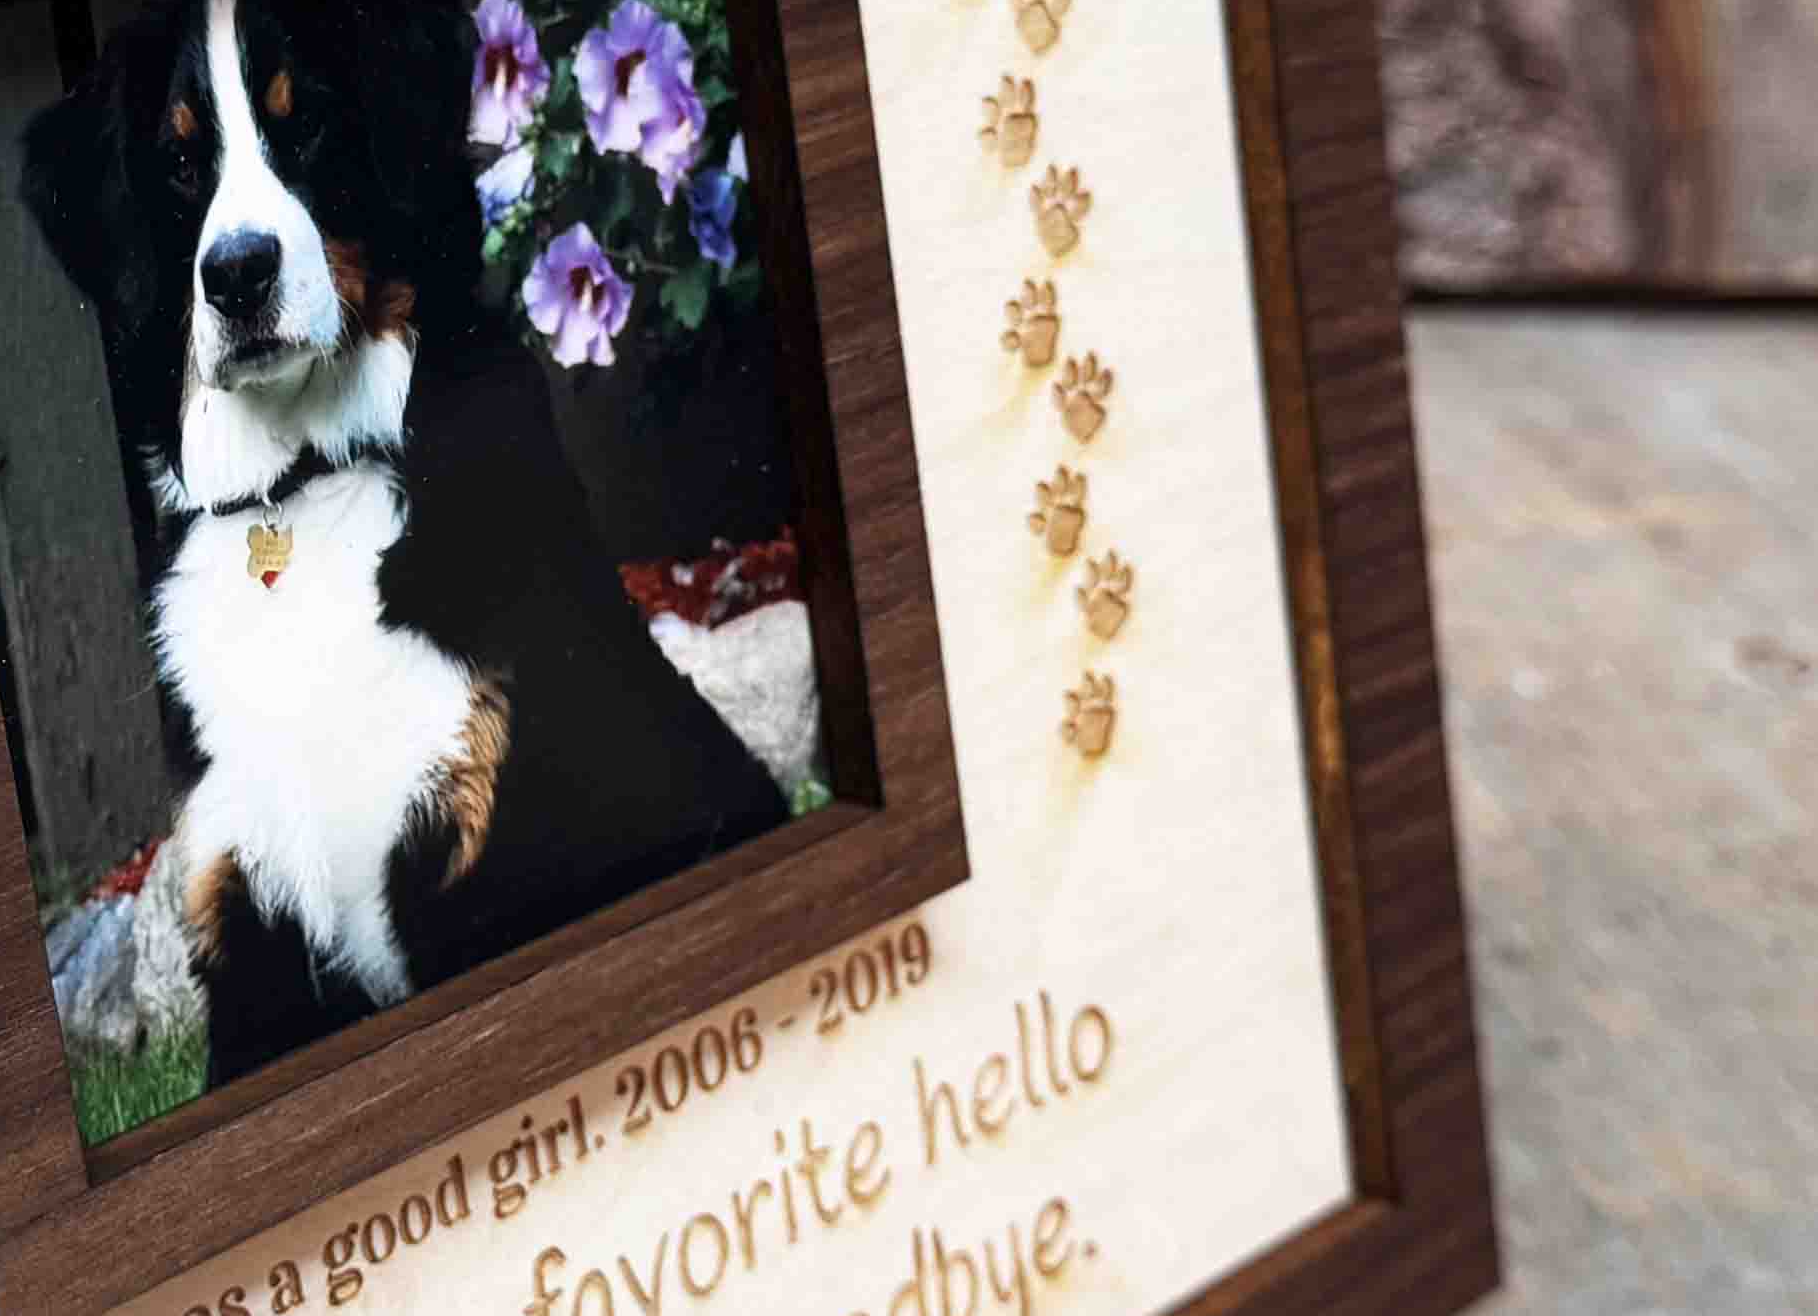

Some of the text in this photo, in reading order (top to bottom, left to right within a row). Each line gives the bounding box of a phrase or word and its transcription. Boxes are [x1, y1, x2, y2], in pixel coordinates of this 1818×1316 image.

[269, 1259, 306, 1315] a
[322, 1156, 471, 1306] good
[489, 1093, 604, 1221] girl.
[614, 1010, 766, 1134] 2006
[808, 920, 933, 1035] 2019
[914, 987, 1116, 1168] hello
